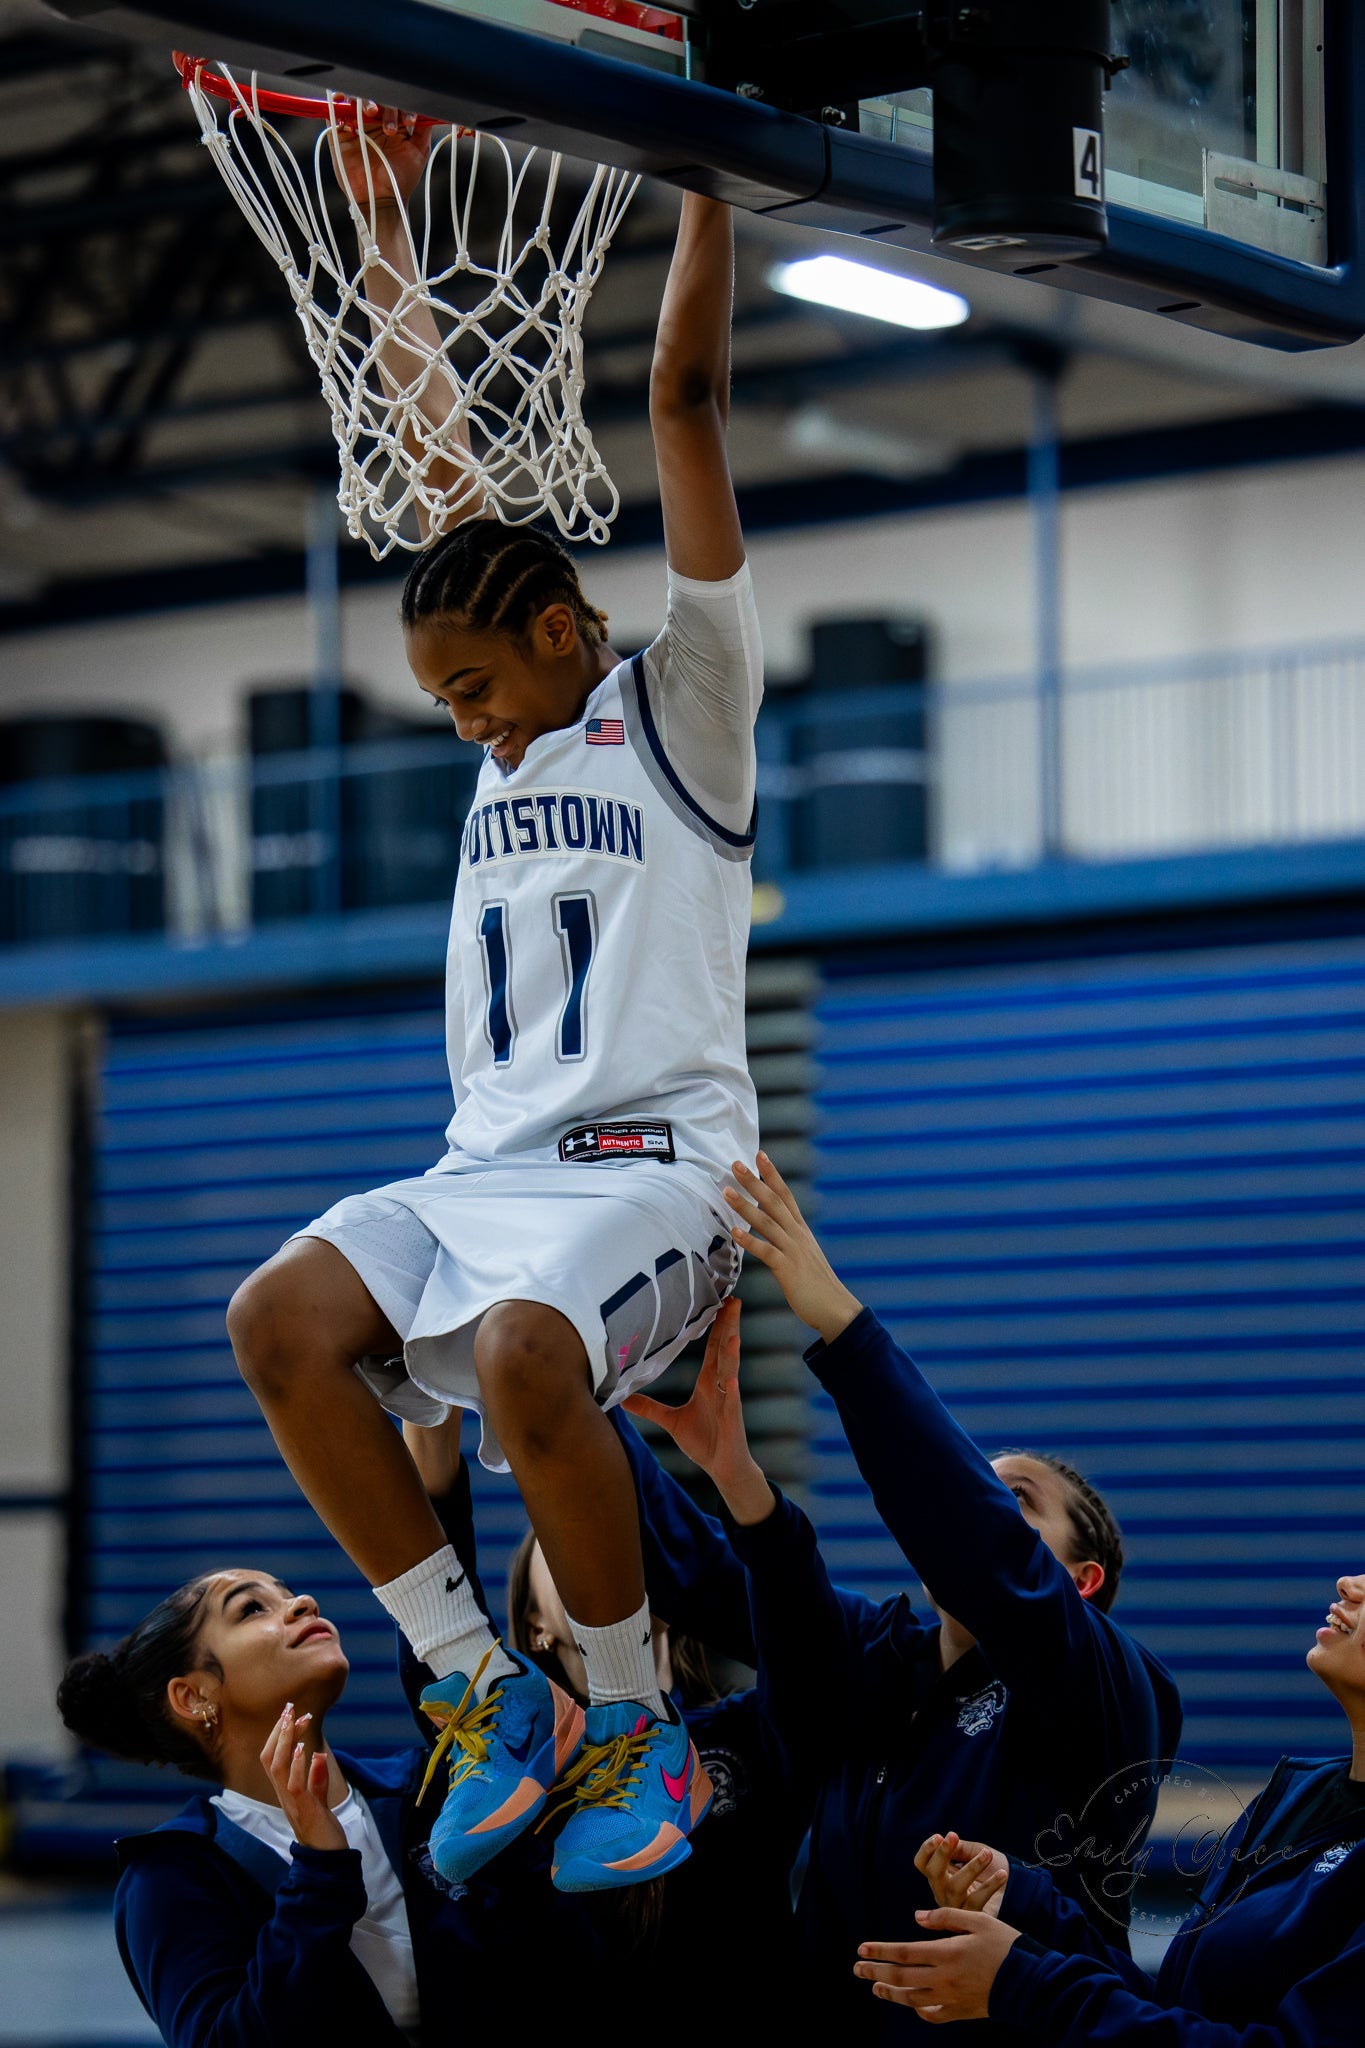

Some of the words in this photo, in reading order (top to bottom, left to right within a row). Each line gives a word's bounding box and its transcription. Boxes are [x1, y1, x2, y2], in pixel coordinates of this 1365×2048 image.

[1080, 135, 1099, 196] 4
[476, 889, 600, 1070] 11
[602, 1138, 641, 1148] AUTHENTIC
